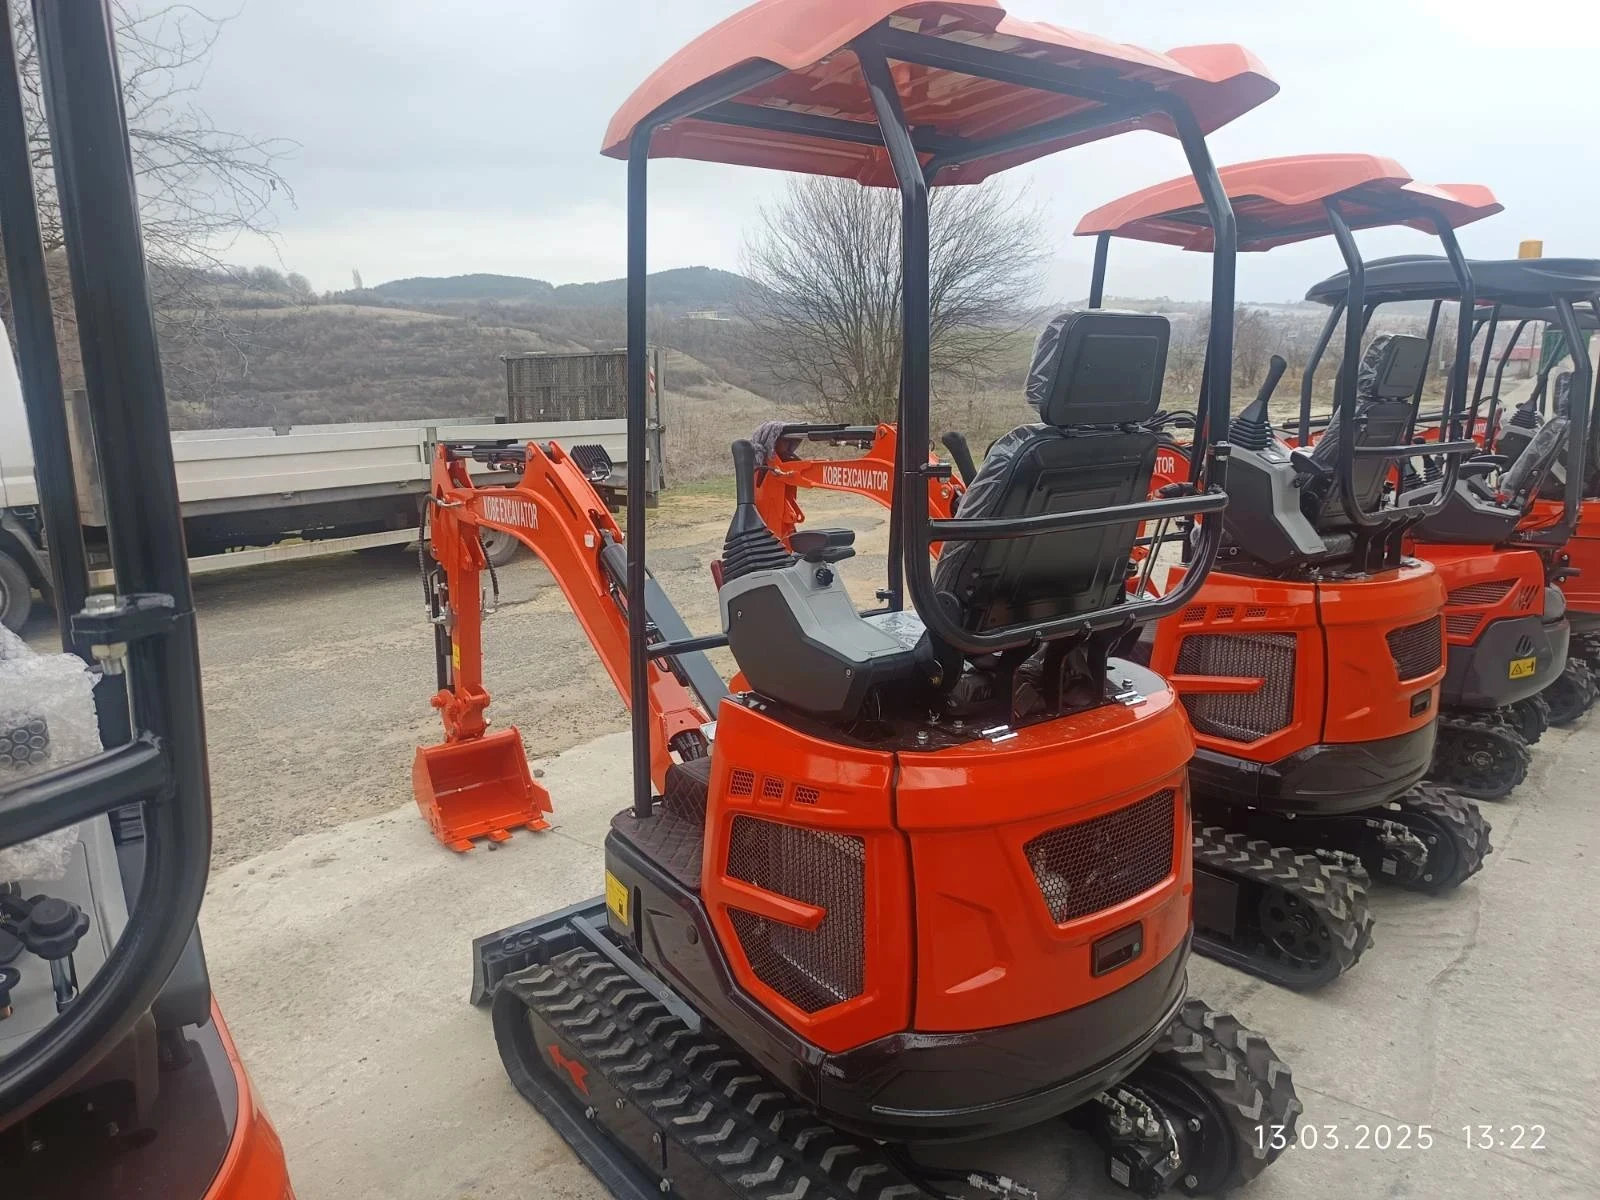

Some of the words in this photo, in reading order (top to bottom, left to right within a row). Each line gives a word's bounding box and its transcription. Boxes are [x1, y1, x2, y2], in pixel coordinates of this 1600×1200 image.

[822, 465, 842, 486] KOBE
[842, 467, 888, 491] EXCAVATOR
[499, 498, 539, 530] EXCAVATOR
